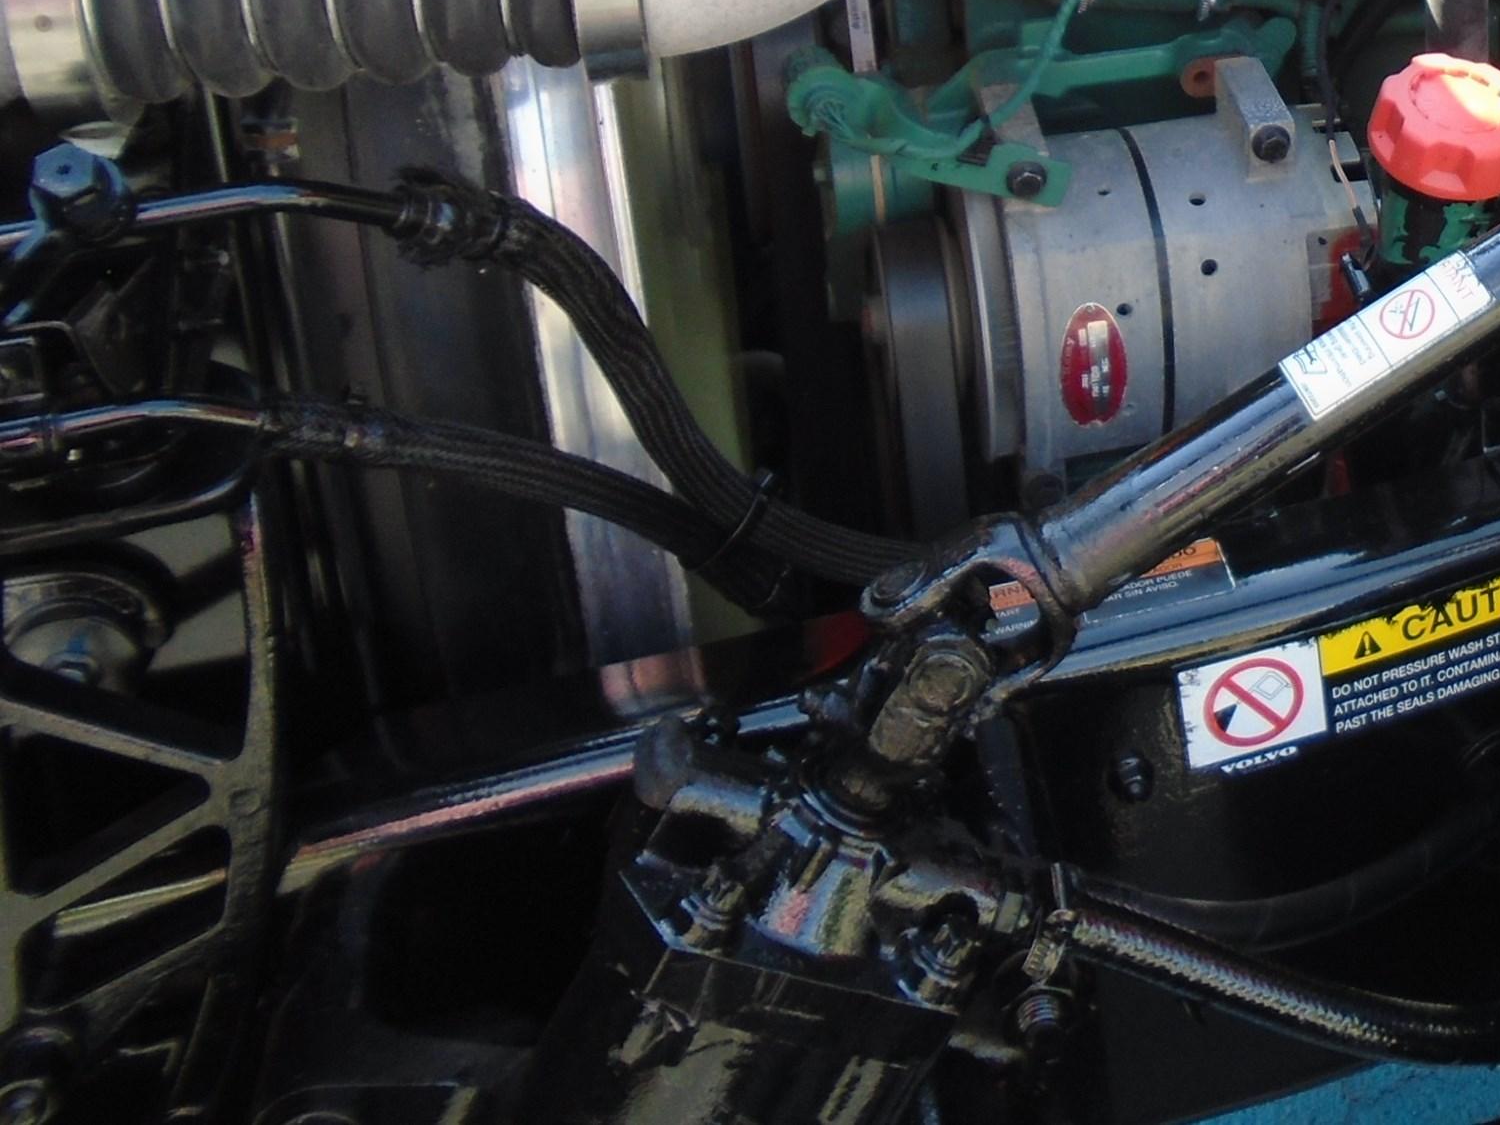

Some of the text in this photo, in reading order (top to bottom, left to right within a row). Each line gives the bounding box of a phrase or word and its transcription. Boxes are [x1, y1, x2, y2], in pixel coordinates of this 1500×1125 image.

[1124, 588, 1144, 599] SIN
[1156, 569, 1192, 583] PUEDE
[1332, 684, 1351, 699] DO
[1354, 674, 1379, 691] NOT
[1382, 651, 1446, 683] PRESSURE
[1448, 638, 1484, 660] WASH
[1333, 686, 1399, 716] ATTACHED
[1402, 679, 1418, 694] TO
[1420, 674, 1435, 688] IT.
[1335, 714, 1367, 734] PAST
[1370, 705, 1395, 722] THE
[1396, 691, 1435, 714] SEALS
[1437, 668, 1500, 700] DAMAGING
[1221, 746, 1297, 774] VOLVO
